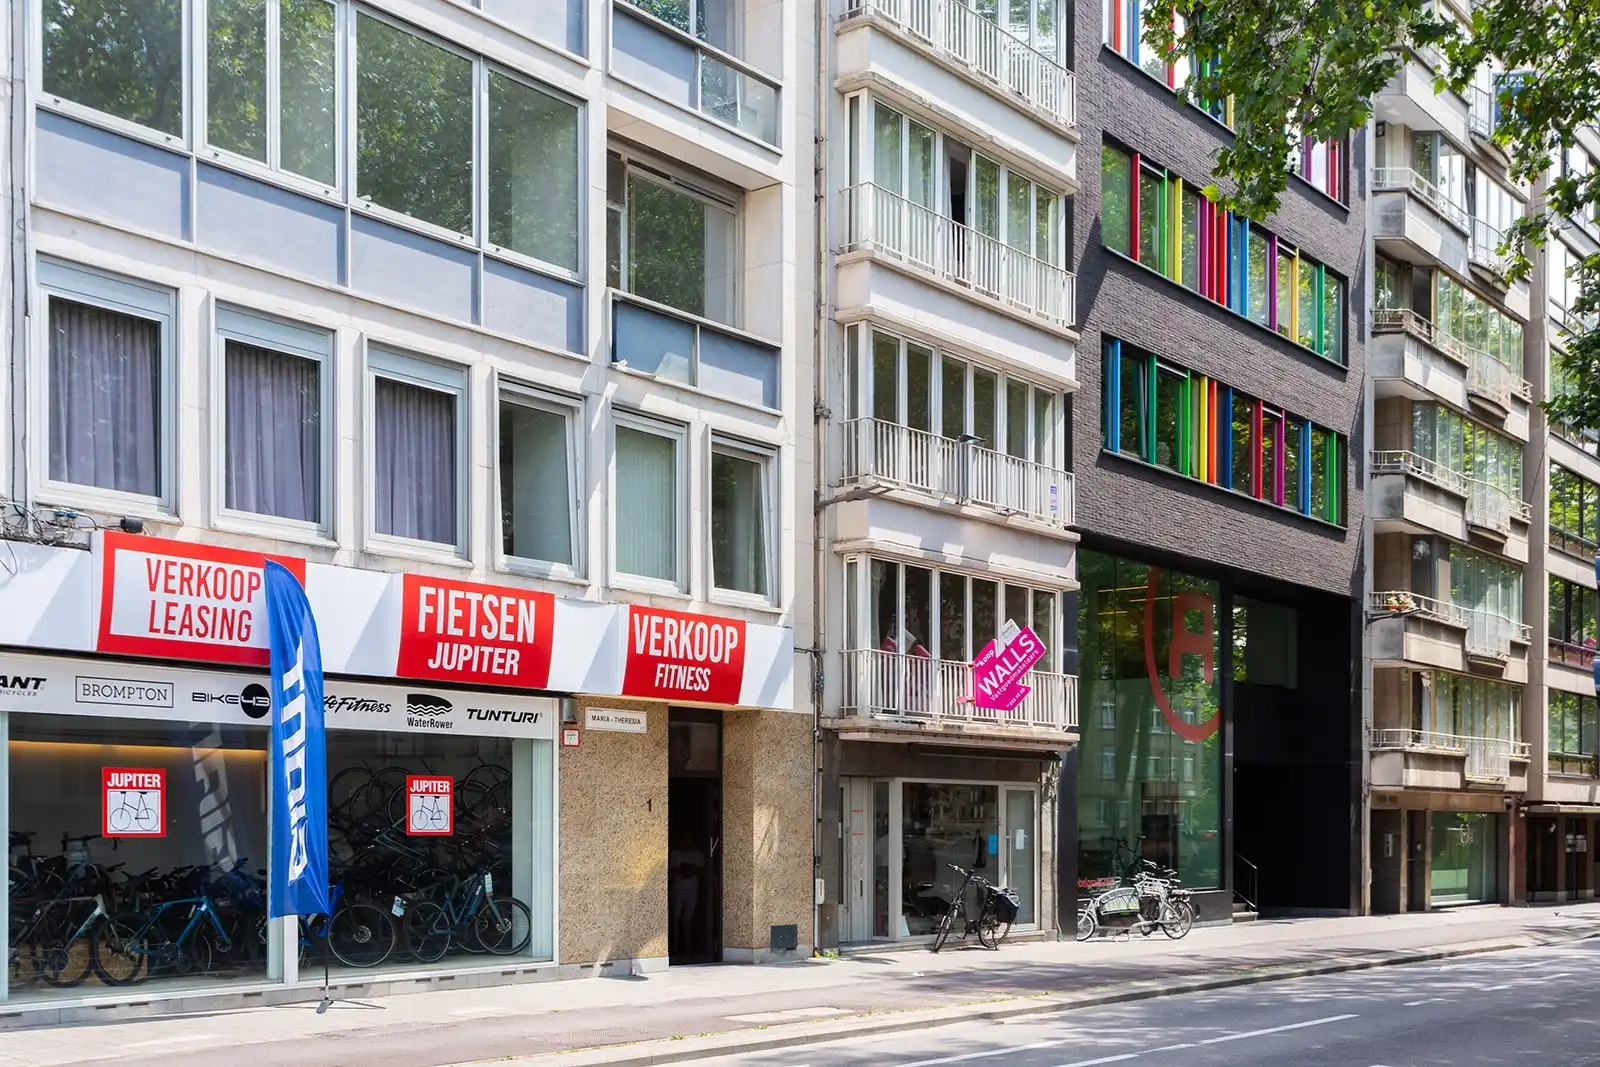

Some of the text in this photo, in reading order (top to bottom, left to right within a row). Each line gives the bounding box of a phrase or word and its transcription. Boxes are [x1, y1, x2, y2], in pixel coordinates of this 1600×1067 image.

[146, 558, 261, 603] VERKOOP
[148, 600, 253, 642] LEASING
[418, 586, 536, 644] FIETSEN
[633, 613, 739, 664] VERKOOP
[428, 641, 521, 676] JUPITER
[978, 634, 1035, 696] WALLS
[980, 649, 995, 667] koop
[82, 683, 168, 701] BROMPTON
[655, 662, 712, 692] FITNESS
[407, 717, 454, 729] WaterRower
[614, 717, 641, 725] THERESIA
[107, 773, 161, 788] JUPITER
[410, 780, 450, 793] JUPITER
